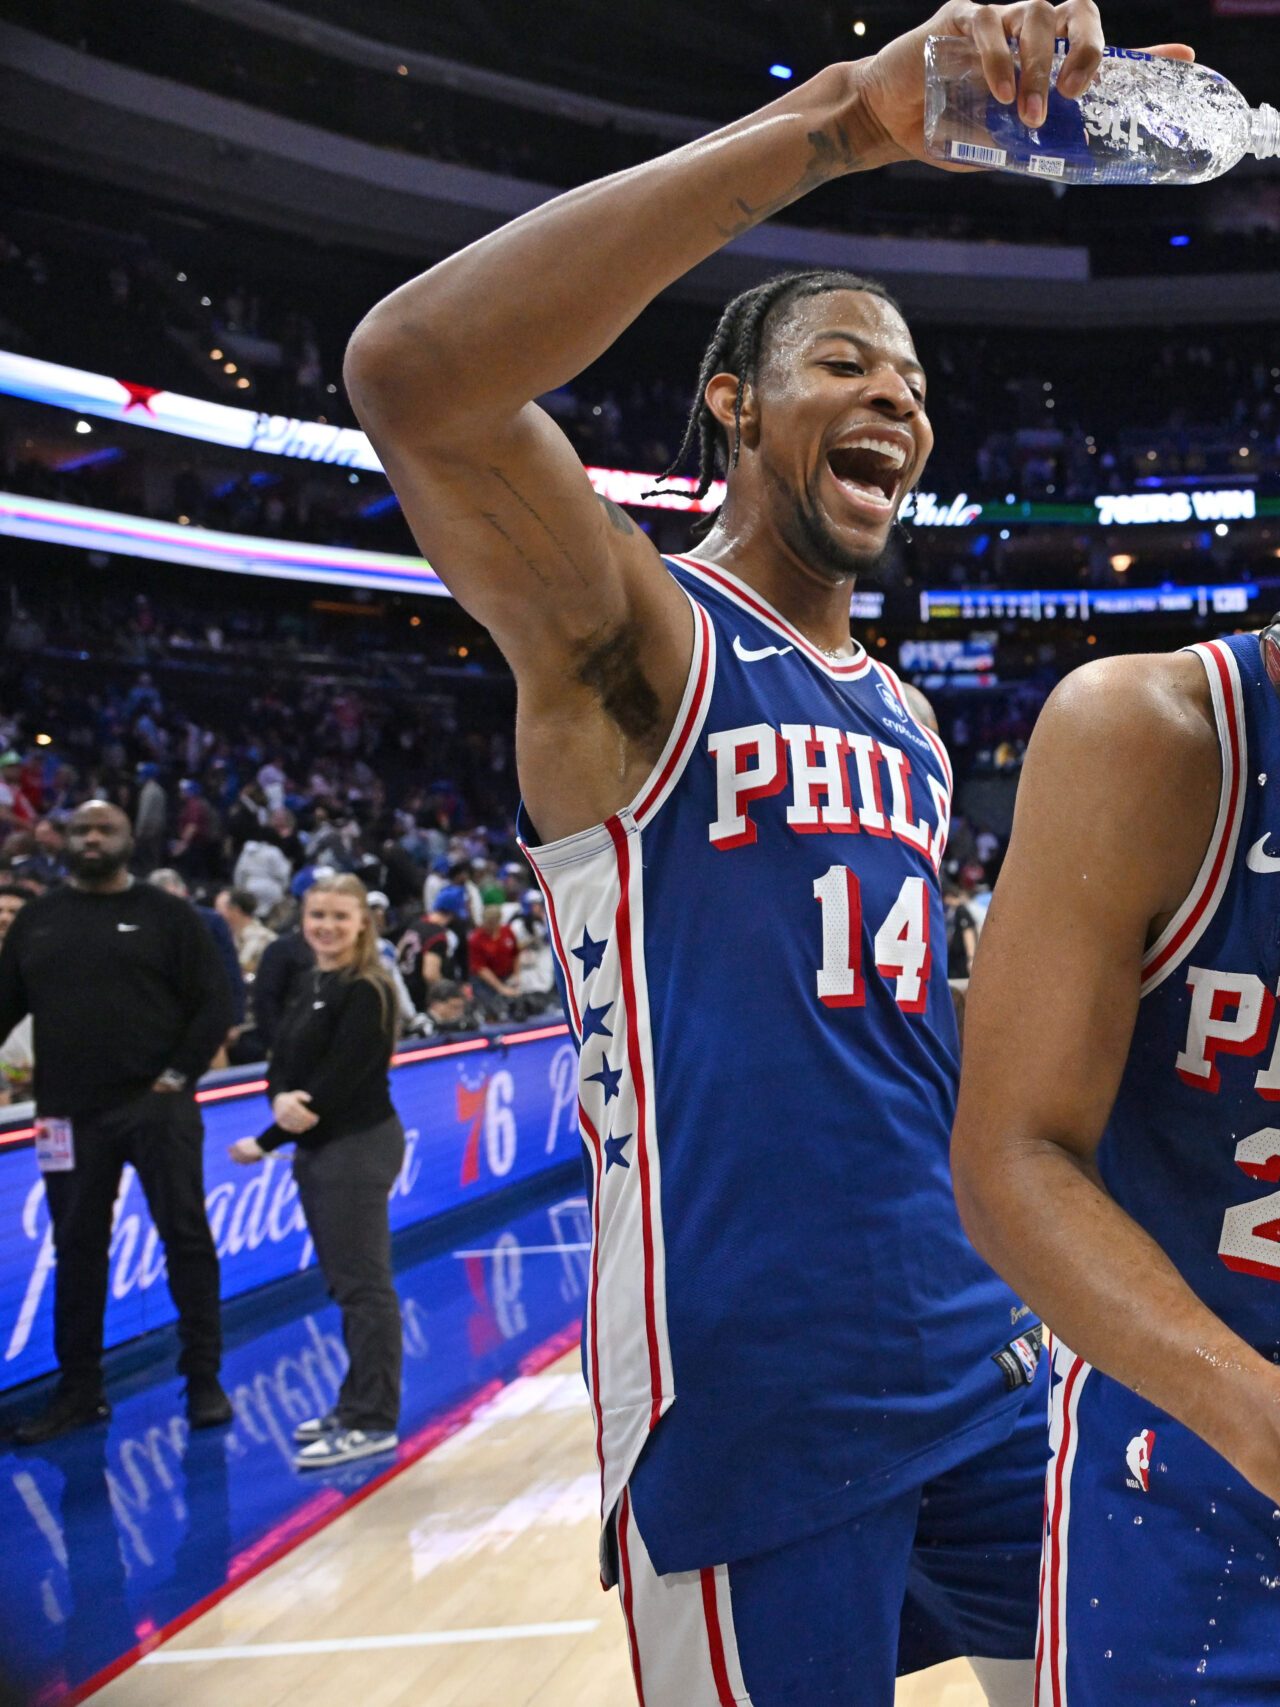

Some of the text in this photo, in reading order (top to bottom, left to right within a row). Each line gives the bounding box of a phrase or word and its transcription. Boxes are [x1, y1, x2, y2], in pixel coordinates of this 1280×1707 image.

[1191, 489, 1256, 521] WIN
[813, 864, 932, 1014] 14
[1126, 1478, 1140, 1489] NBA
